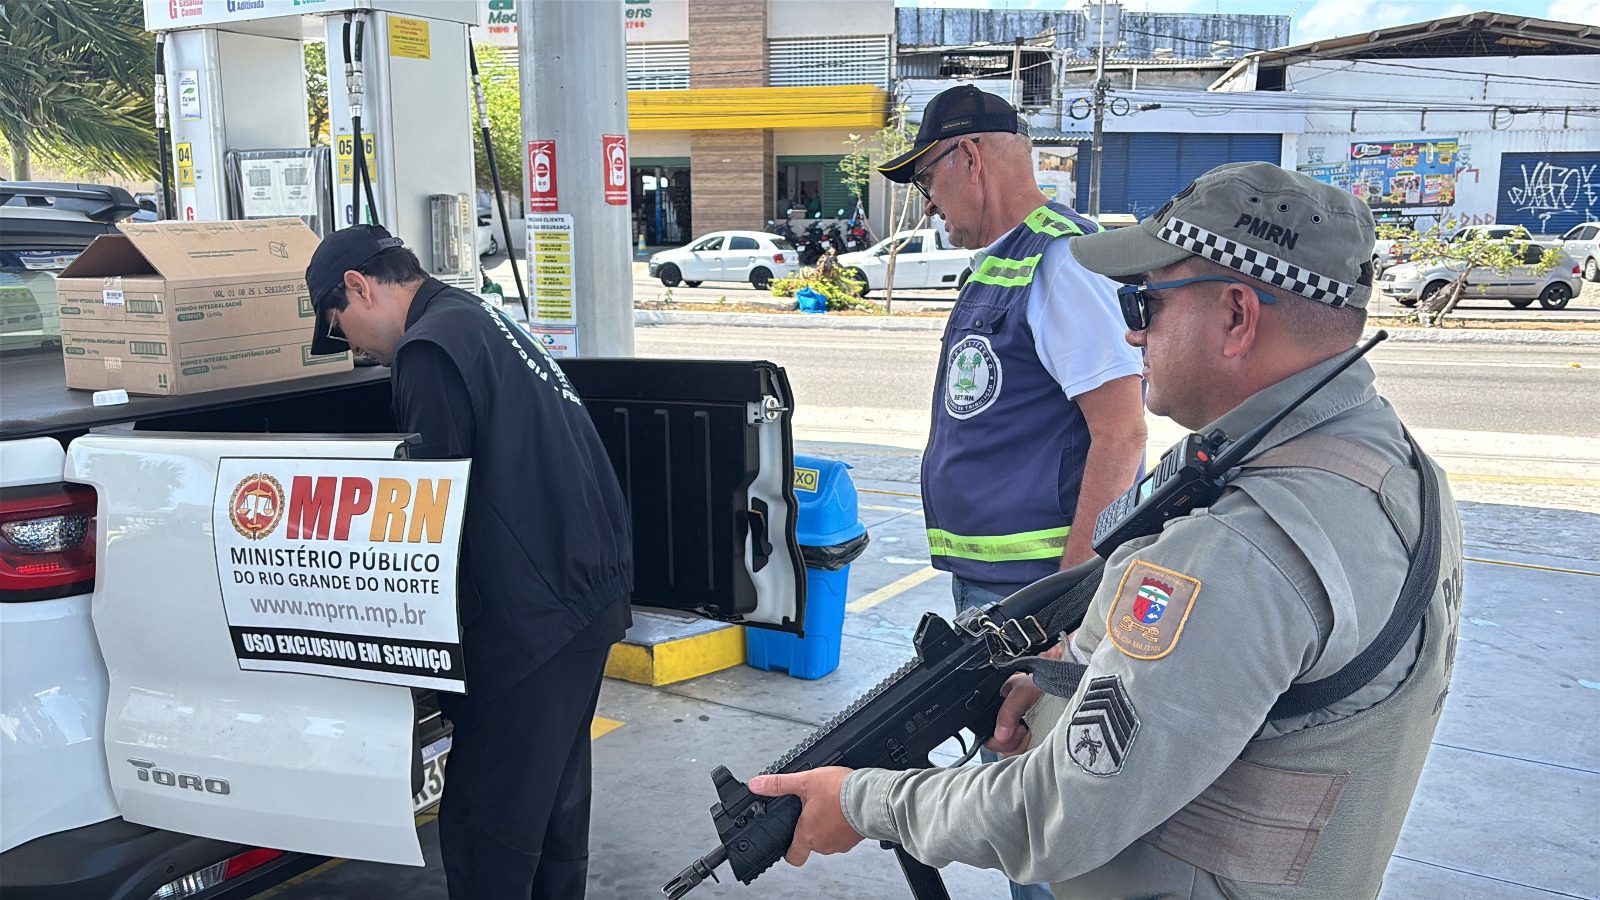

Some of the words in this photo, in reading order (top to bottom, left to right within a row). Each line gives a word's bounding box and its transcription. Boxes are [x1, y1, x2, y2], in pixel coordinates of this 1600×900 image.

[178, 147, 190, 162] 04
[339, 139, 352, 155] 05
[1234, 213, 1299, 250] PMRN
[198, 302, 224, 310] INTEGRAL
[213, 290, 225, 298] VAL
[228, 289, 235, 297] 01
[794, 471, 815, 486] XO
[286, 475, 452, 543] MPRN
[231, 545, 342, 569] MINISTÉRIO
[349, 547, 440, 573] PÚBLICO
[233, 570, 255, 585] DO
[259, 572, 284, 586] RIO
[288, 573, 351, 590] GRANDE
[355, 577, 379, 592] DO
[384, 578, 440, 594] NORTE
[250, 597, 427, 628] www.mprn.mp.br
[241, 633, 275, 654] USO
[275, 635, 357, 661] EXCLUSIVO
[357, 642, 382, 664] EM
[384, 645, 452, 673] SERVIÇO
[127, 757, 231, 795] TORO
